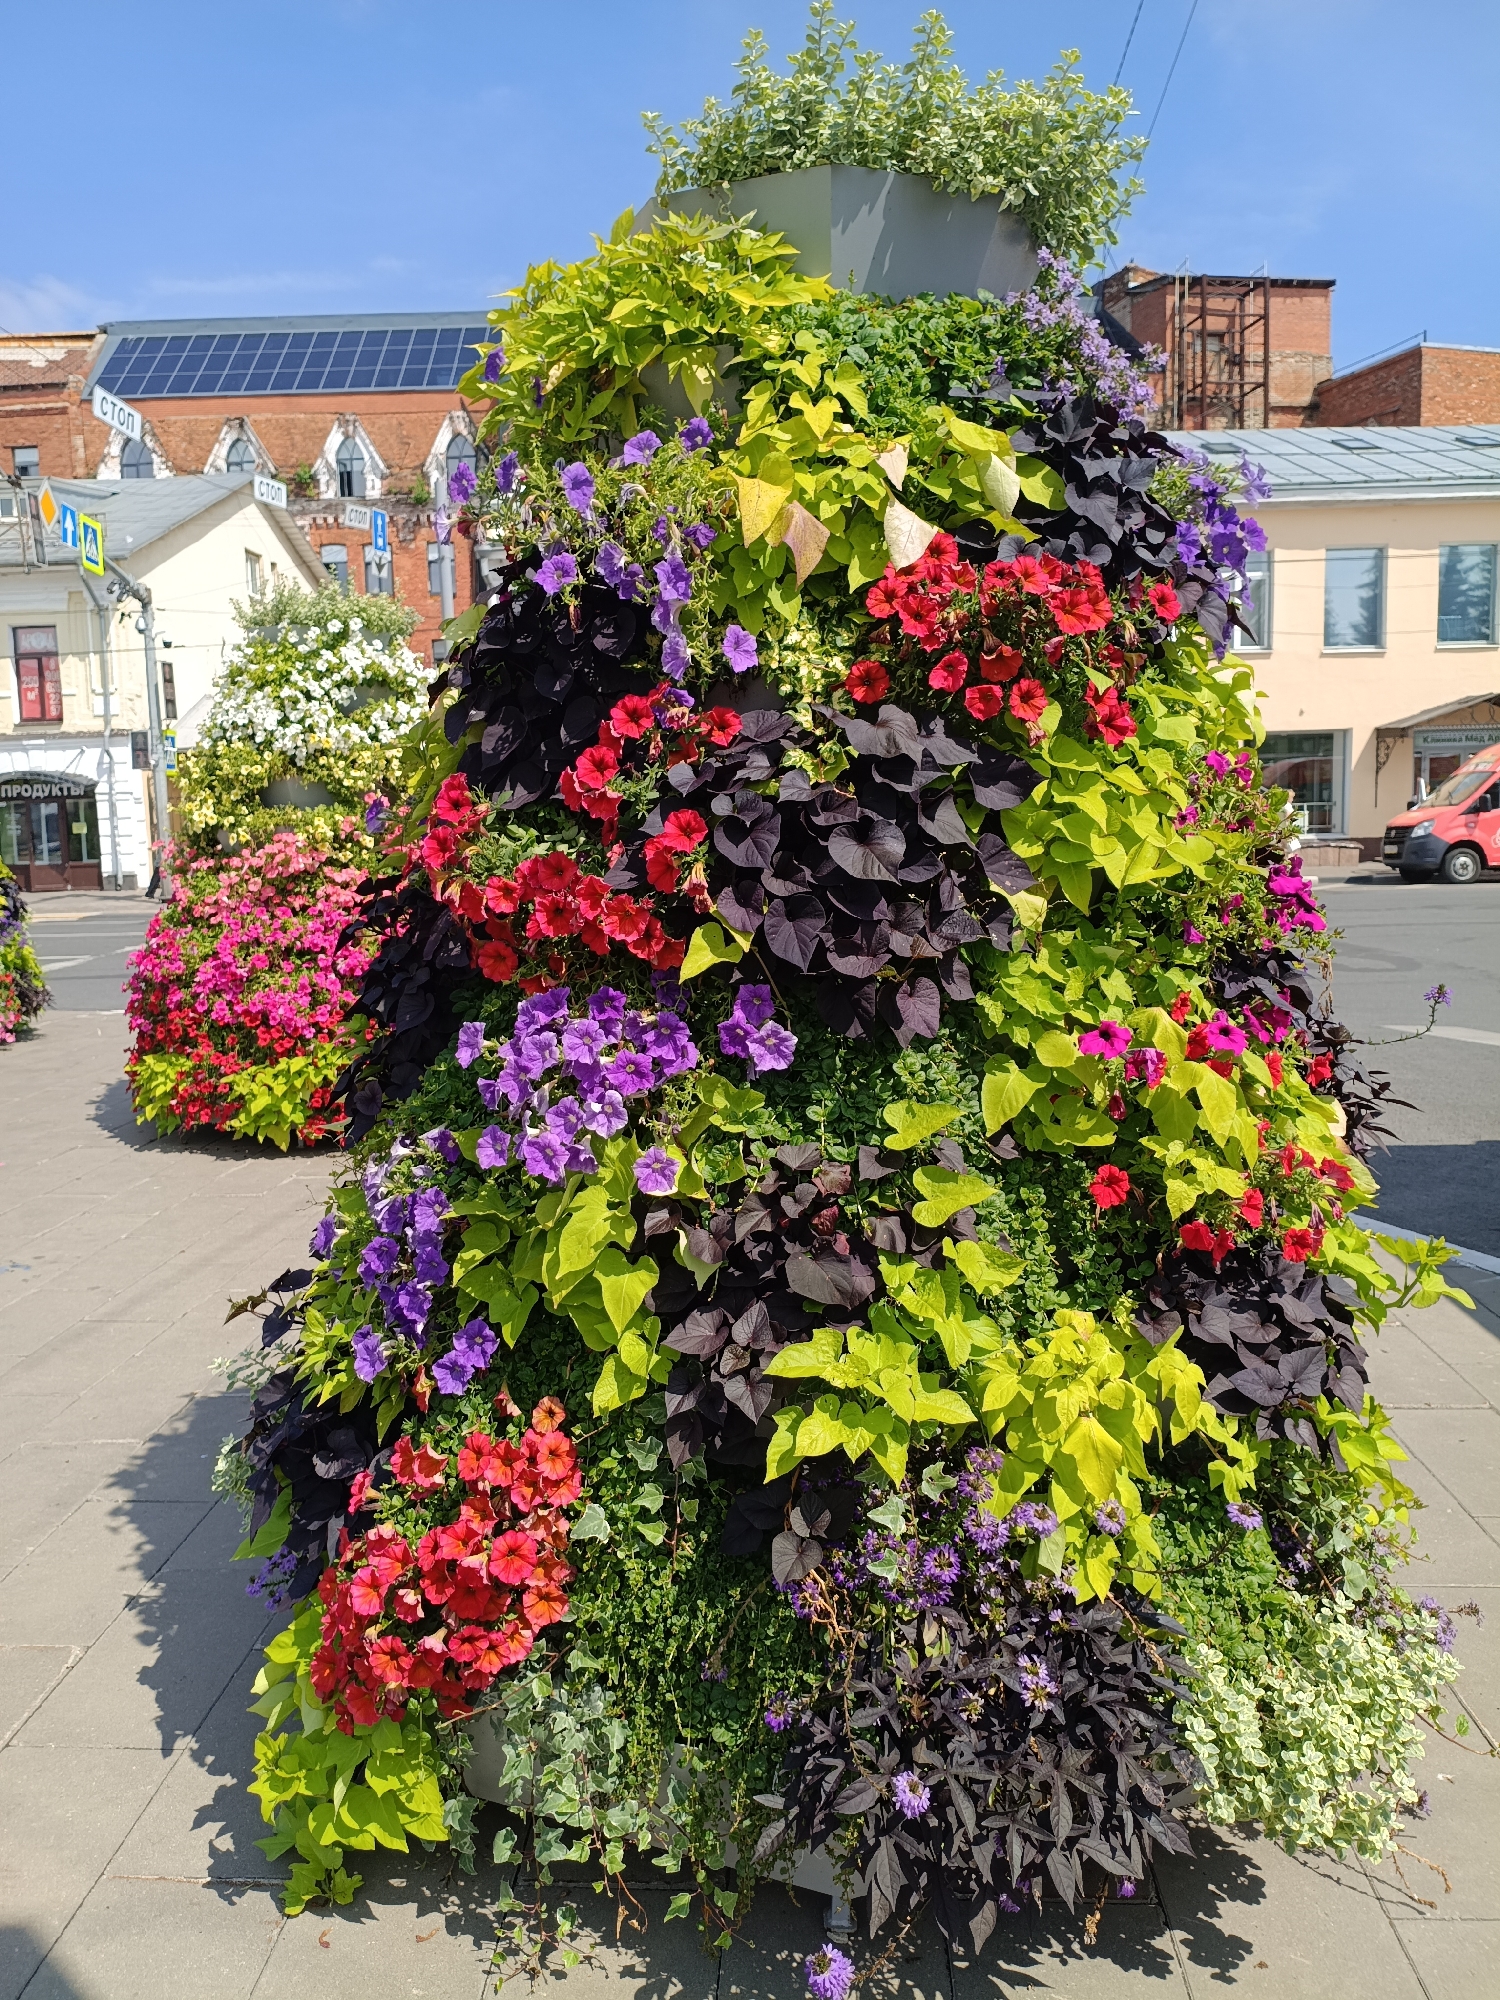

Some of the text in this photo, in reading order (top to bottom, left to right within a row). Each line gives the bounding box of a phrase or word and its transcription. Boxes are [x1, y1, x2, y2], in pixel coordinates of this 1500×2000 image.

[100, 396, 135, 433] СТОП
[257, 480, 283, 504] СТОП
[347, 508, 368, 526] СТОП
[1, 783, 85, 799] ПРОДУКТЫ
